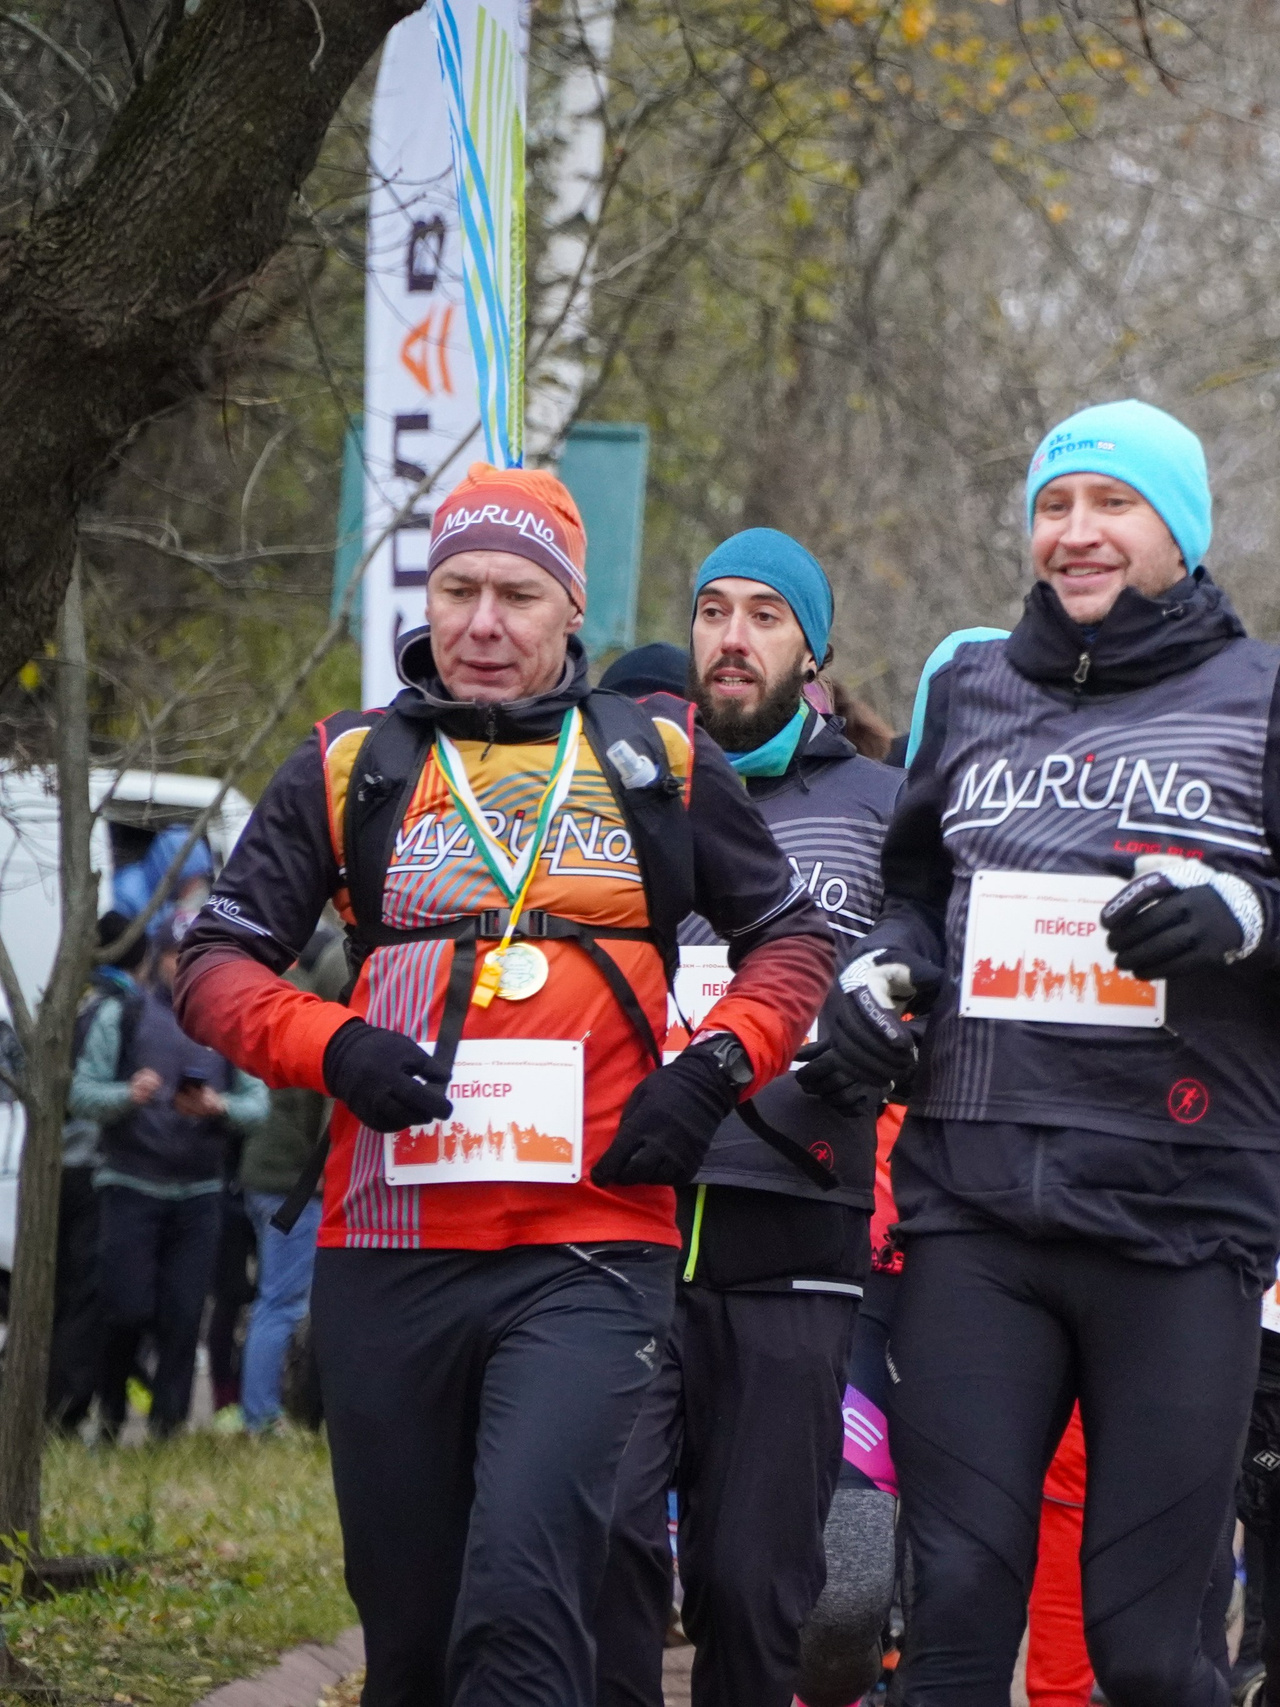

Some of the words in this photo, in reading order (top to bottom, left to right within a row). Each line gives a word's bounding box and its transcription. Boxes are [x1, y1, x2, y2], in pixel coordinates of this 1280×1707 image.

[1034, 916, 1097, 937] ПЕЙСЕР
[702, 980, 731, 997] ПЕЙ
[450, 1080, 513, 1099] ПЕЙСЕР
